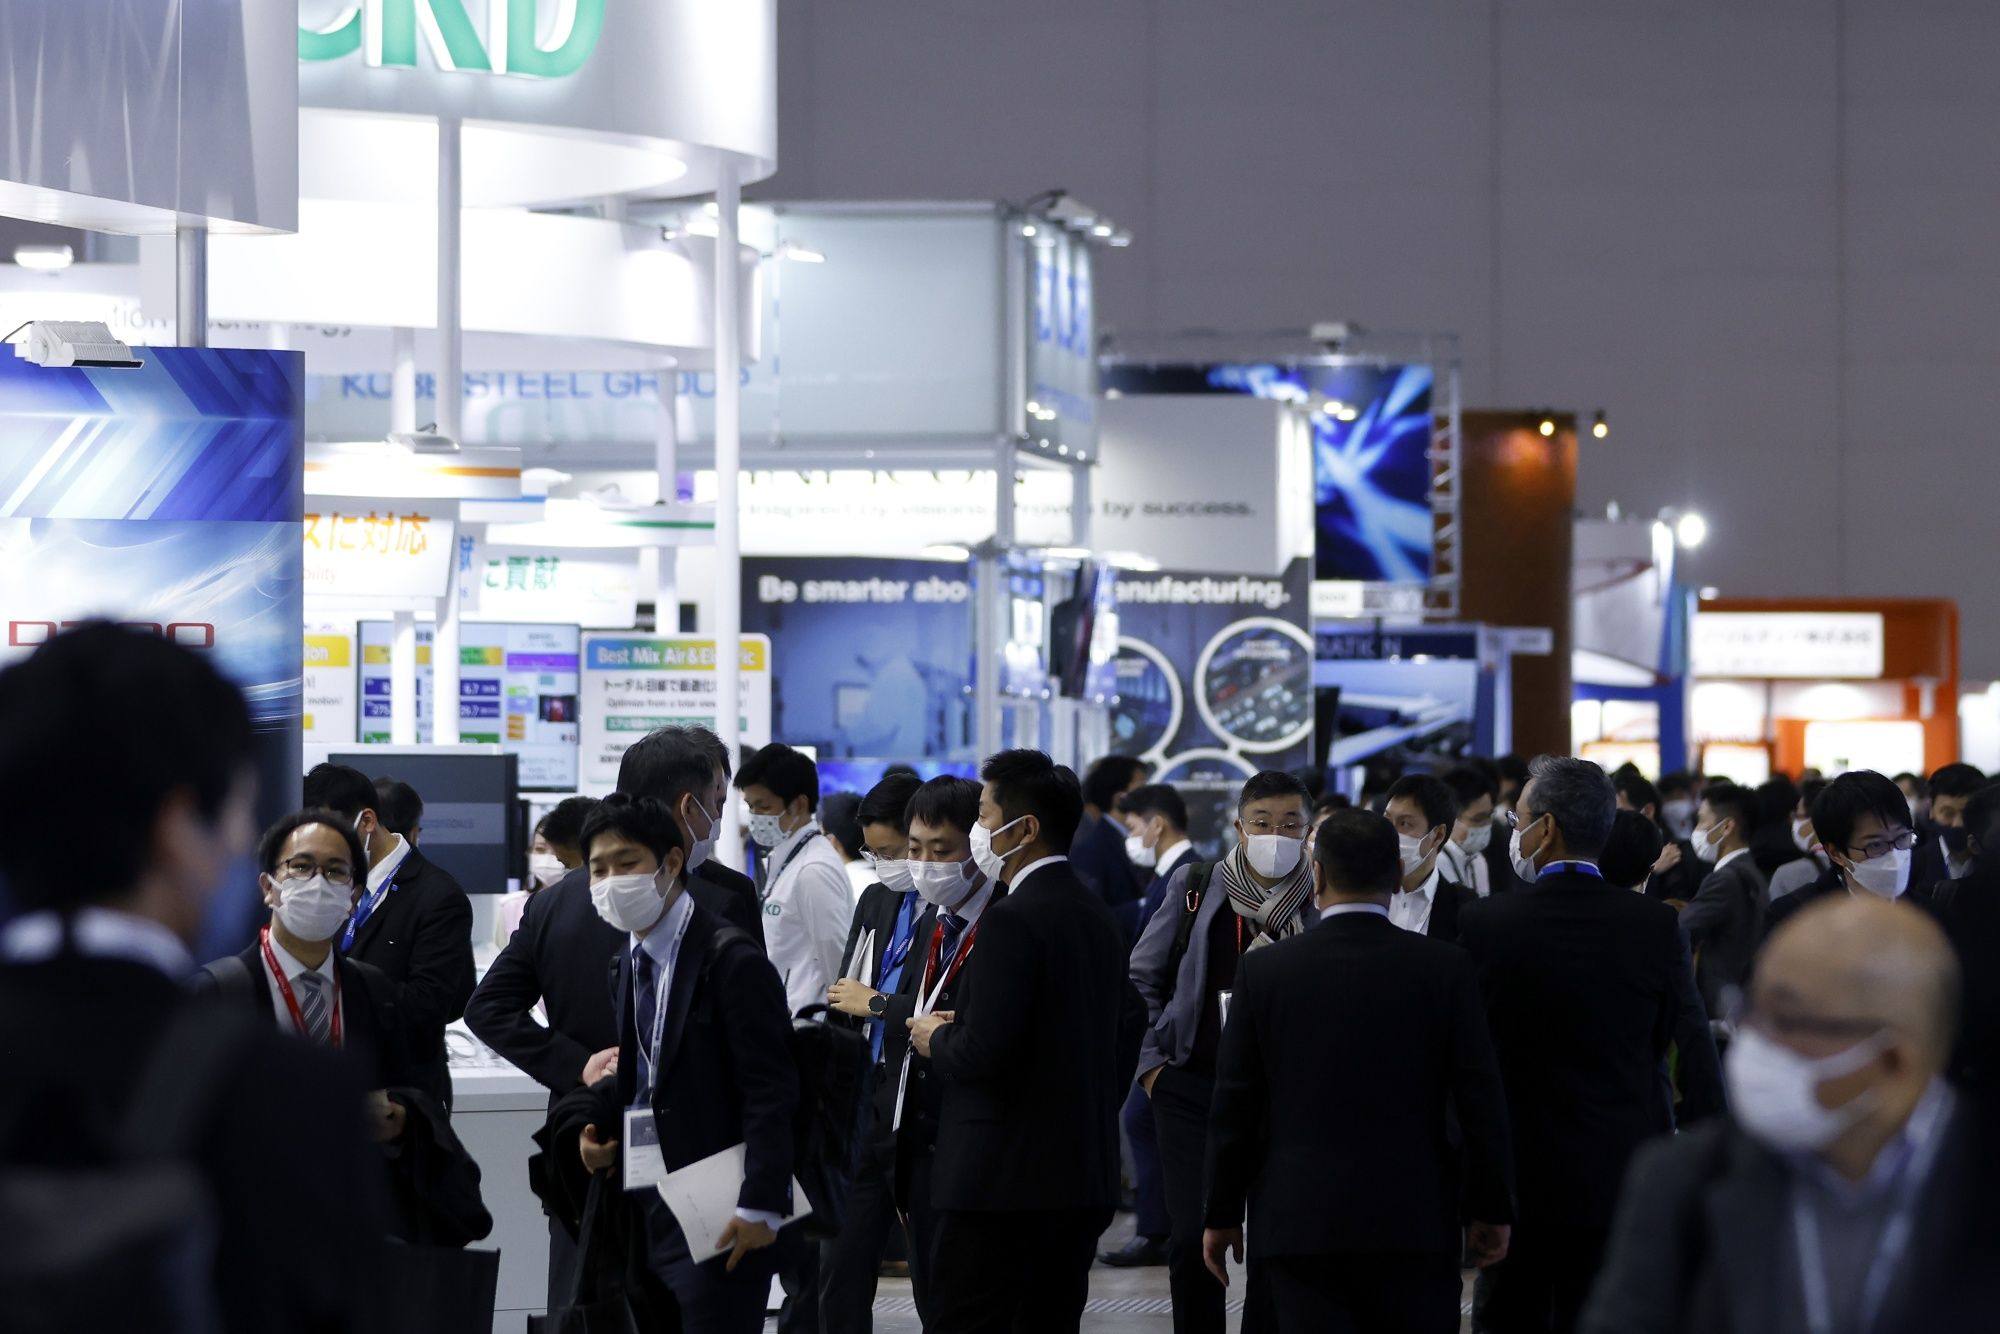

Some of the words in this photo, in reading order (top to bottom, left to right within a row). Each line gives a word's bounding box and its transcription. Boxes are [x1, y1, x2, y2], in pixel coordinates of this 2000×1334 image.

[758, 574, 798, 602] Be
[803, 576, 909, 602] smarter
[597, 647, 629, 665] Best
[633, 647, 660, 665] Mix
